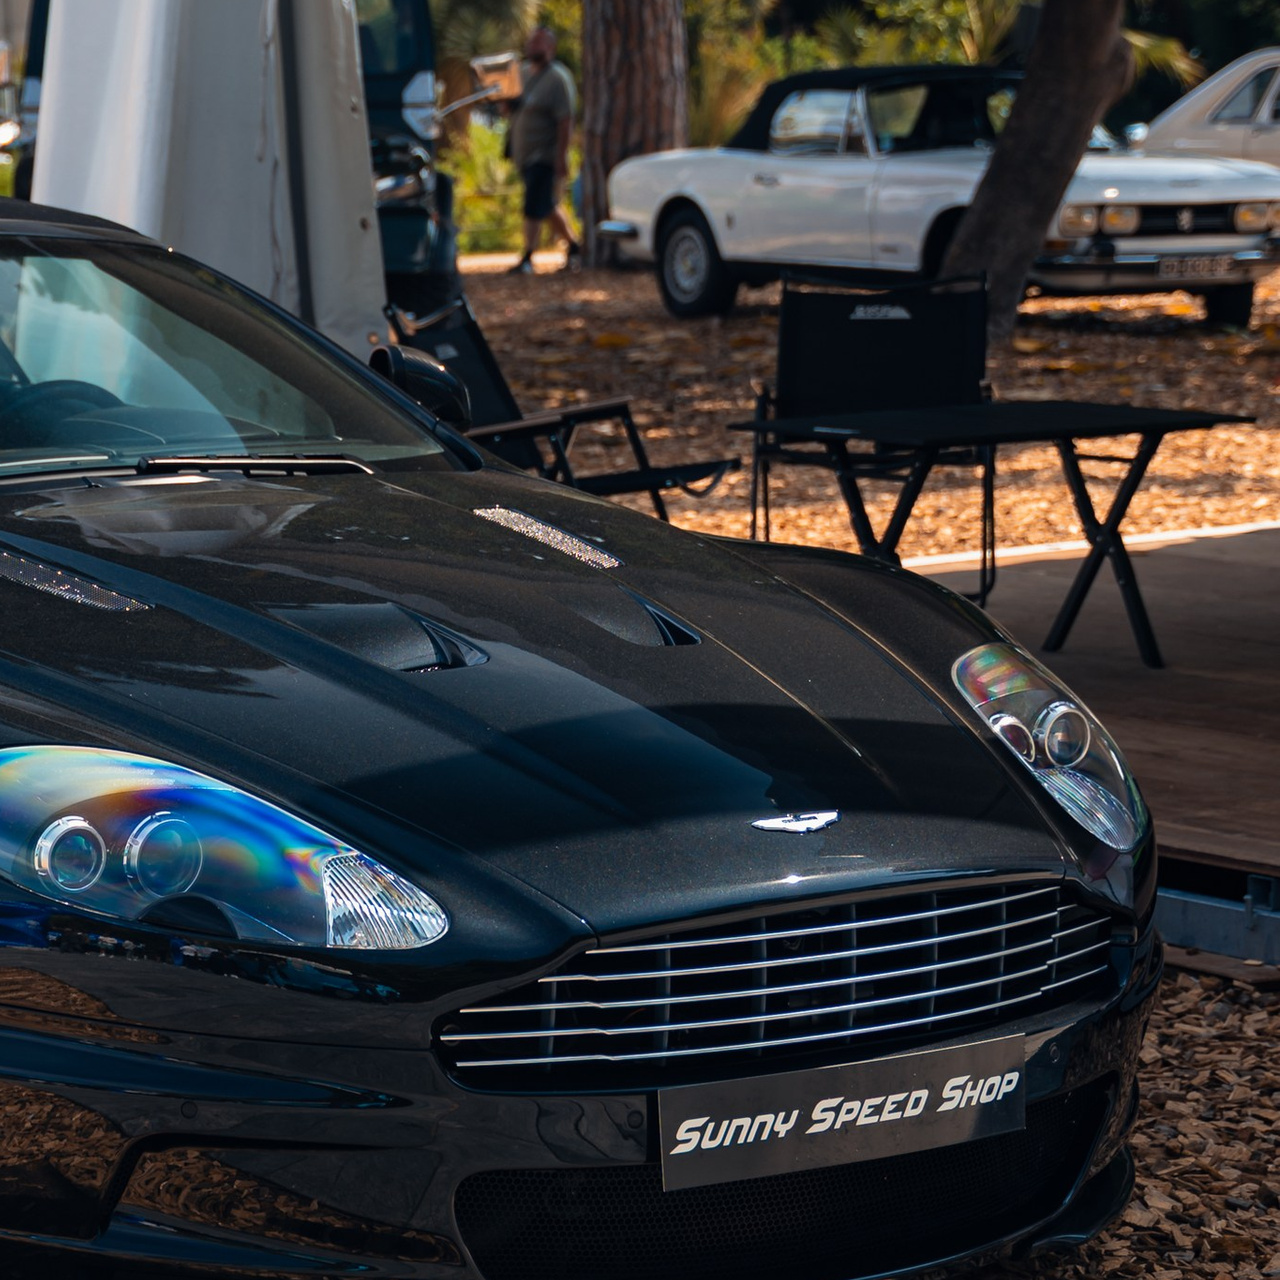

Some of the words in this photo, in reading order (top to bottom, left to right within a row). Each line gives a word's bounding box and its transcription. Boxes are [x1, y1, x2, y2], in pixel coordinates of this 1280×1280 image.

[669, 1109, 799, 1156] SUNNY
[805, 1088, 929, 1135] SPEED
[936, 1070, 1020, 1113] SHOP
